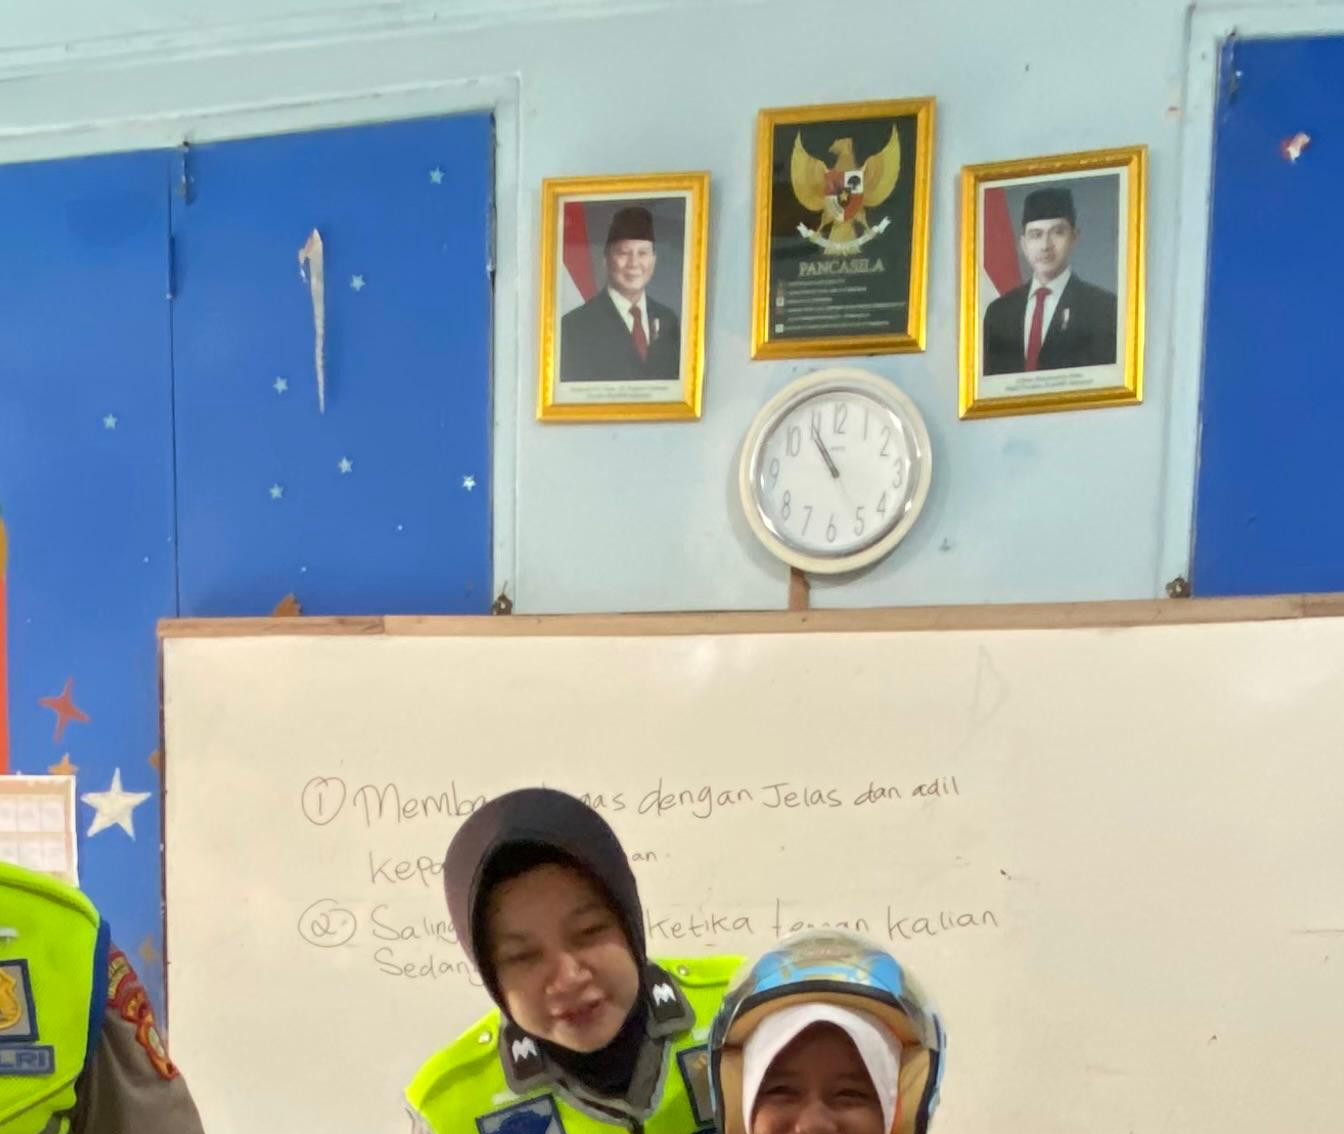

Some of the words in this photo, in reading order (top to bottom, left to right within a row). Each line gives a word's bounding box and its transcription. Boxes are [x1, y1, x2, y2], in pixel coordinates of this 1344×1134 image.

[799, 258, 885, 277] PANCASILA
[831, 402, 848, 435] 12
[785, 425, 801, 457] 10
[879, 425, 891, 457] 2
[769, 457, 780, 489] 9
[892, 457, 903, 489] 3
[781, 490, 791, 521] 8
[876, 491, 887, 517] 4
[802, 506, 813, 536] 7
[826, 512, 837, 543] 6
[854, 506, 865, 536] 5
[638, 778, 754, 819] dengan
[853, 780, 903, 807] dan
[912, 776, 960, 797] adil
